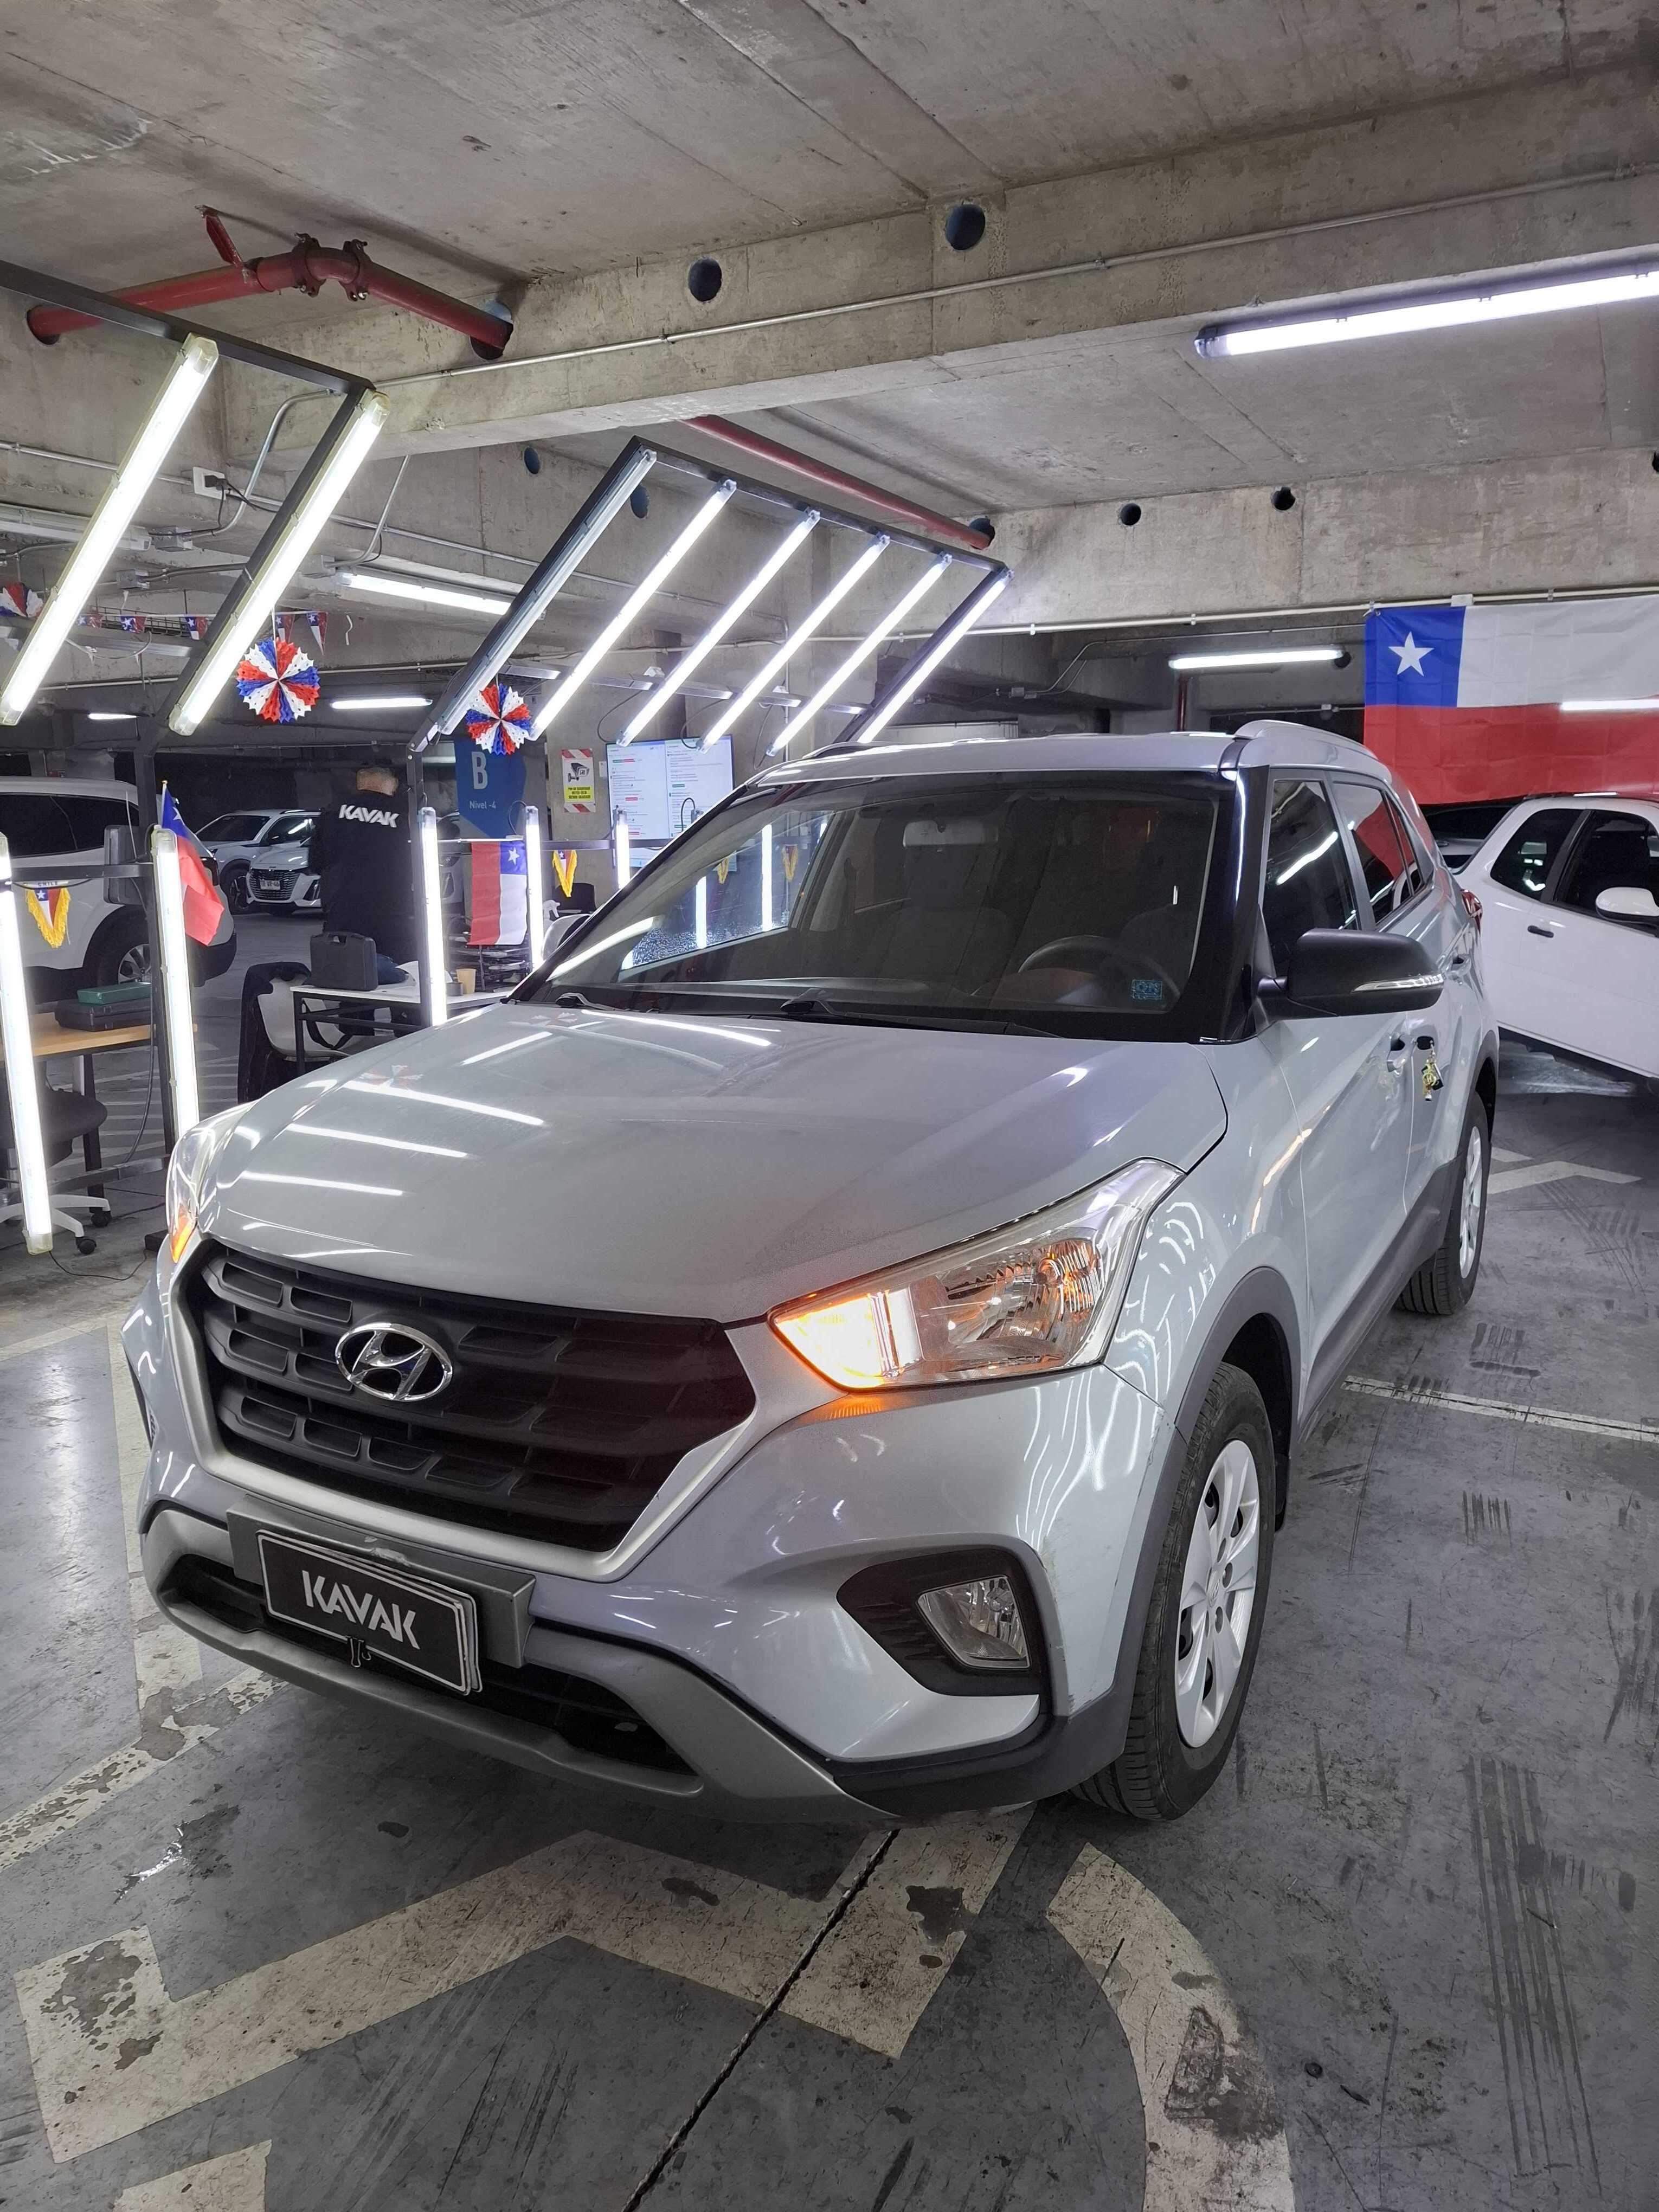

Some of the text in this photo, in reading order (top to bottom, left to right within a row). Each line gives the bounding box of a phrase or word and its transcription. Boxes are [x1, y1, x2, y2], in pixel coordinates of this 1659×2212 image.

[471, 751, 488, 789] B
[338, 804, 400, 828] KAVAK
[470, 800, 497, 809] Nivel -4
[302, 1570, 420, 1650] KAVAK
